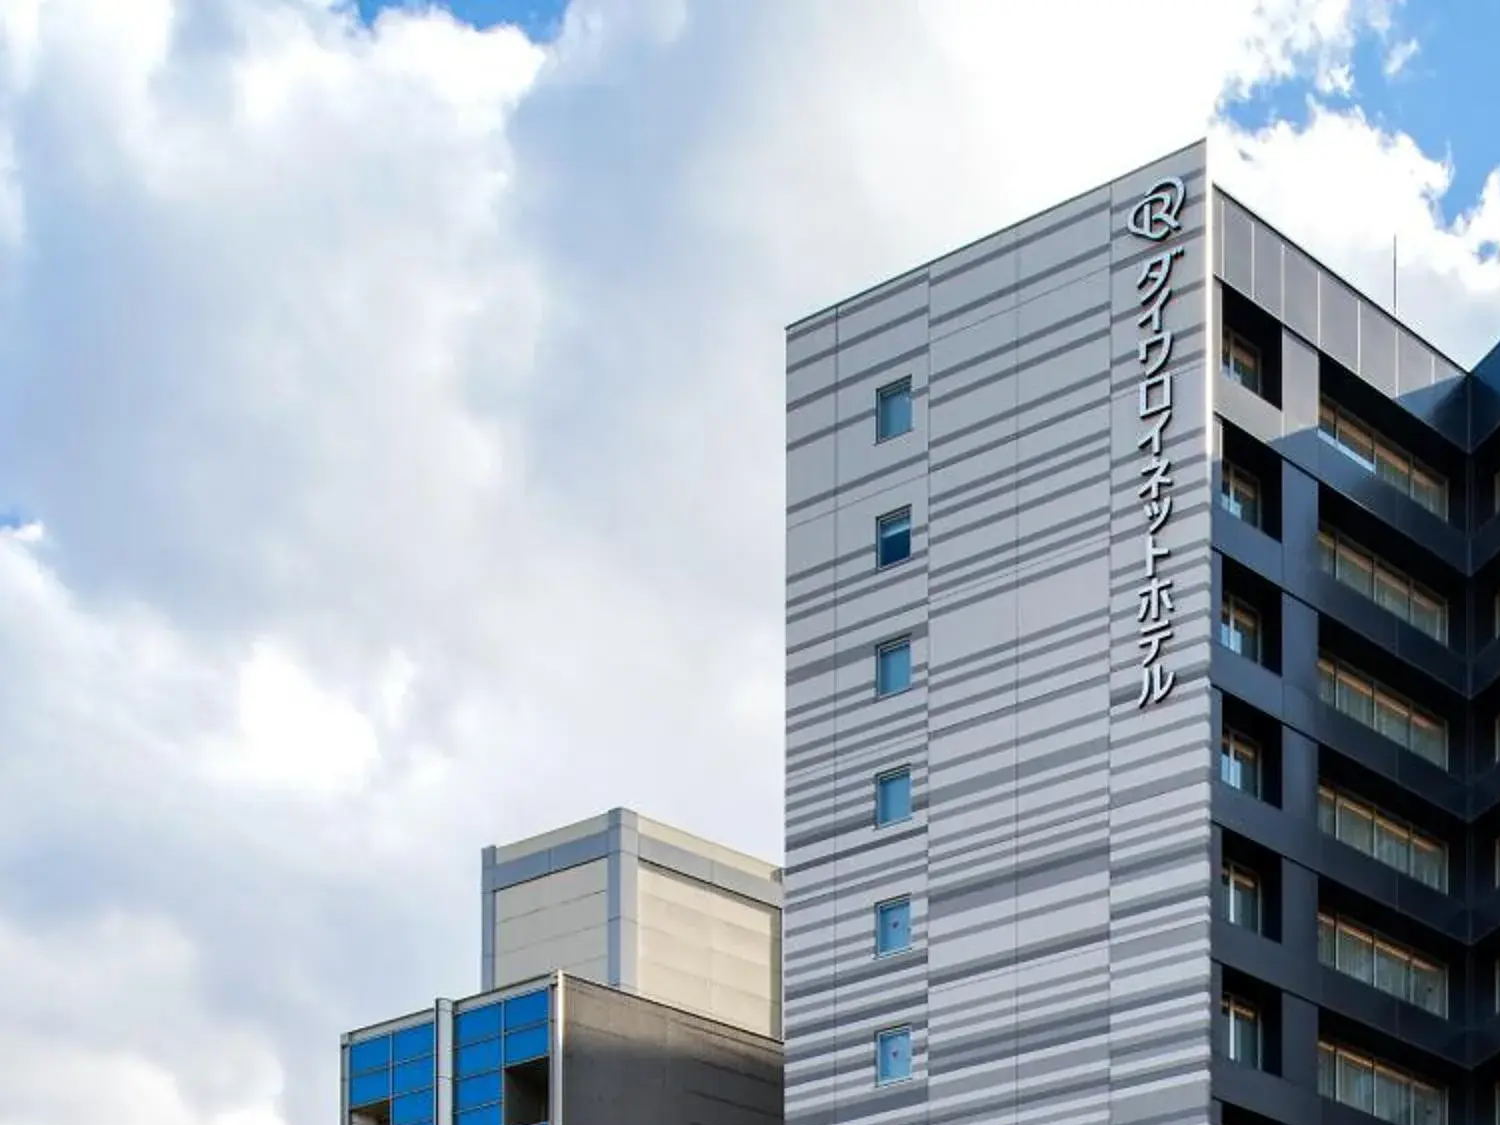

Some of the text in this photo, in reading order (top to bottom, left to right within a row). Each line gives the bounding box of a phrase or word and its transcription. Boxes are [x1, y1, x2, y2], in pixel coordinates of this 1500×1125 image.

[1137, 246, 1185, 708] ダイワロイネットホテル
